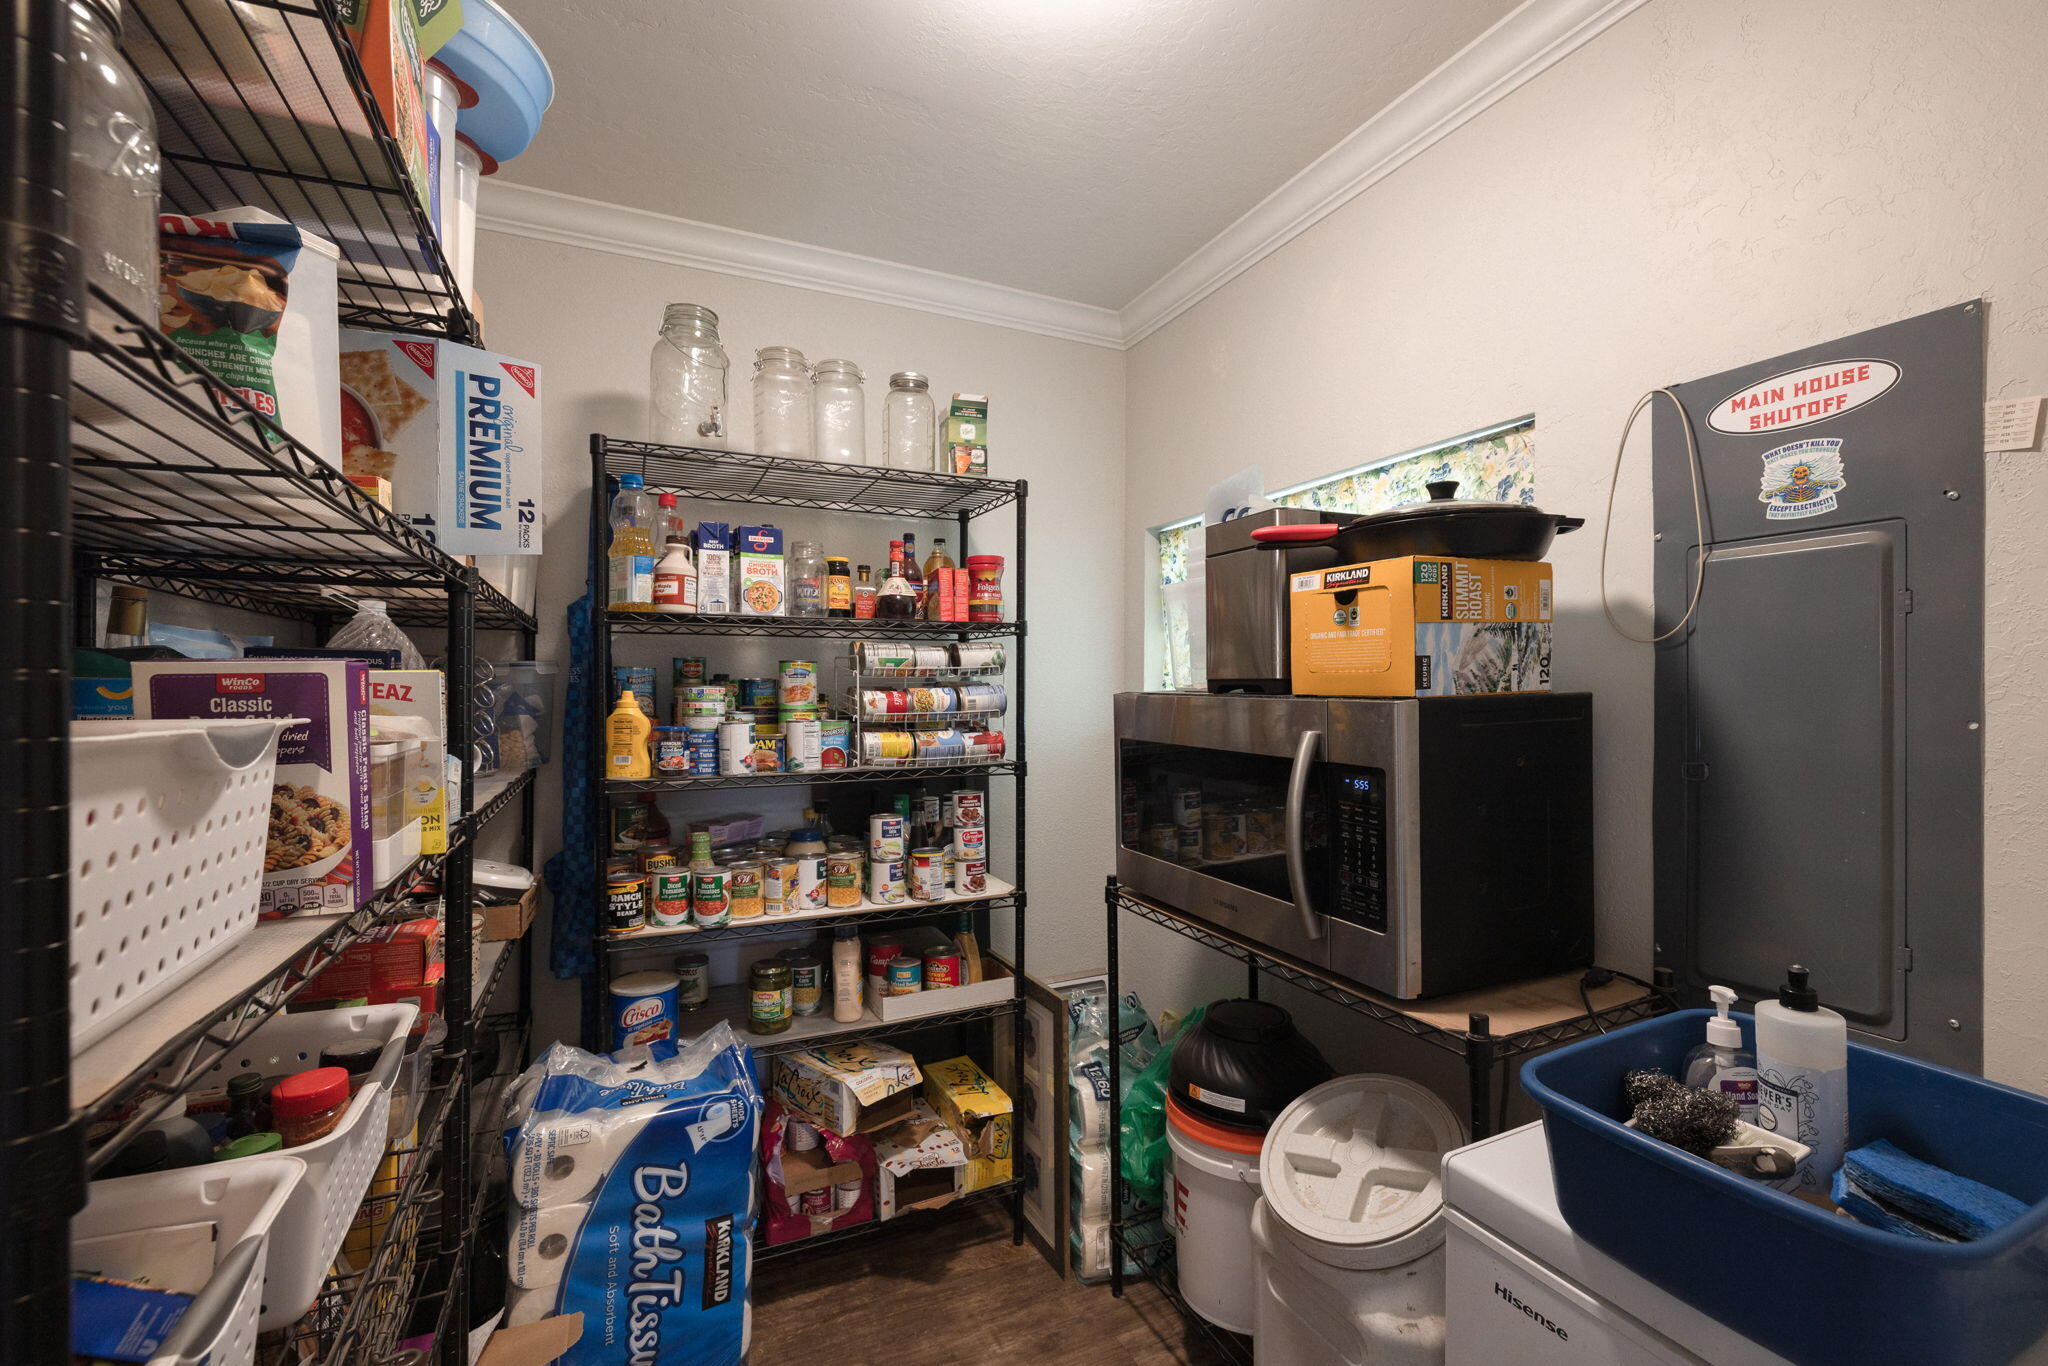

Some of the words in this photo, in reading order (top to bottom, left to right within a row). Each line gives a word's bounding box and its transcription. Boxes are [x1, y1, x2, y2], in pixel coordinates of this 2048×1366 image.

[176, 337, 206, 346] Because
[208, 340, 228, 349] when
[182, 346, 225, 359] RUNCHES
[229, 353, 247, 362] ARE
[409, 345, 431, 366] NABISCO
[212, 360, 254, 372] STRENGTH
[246, 374, 271, 384] become
[512, 367, 533, 387] NABISCO
[1730, 386, 1785, 414] MAIN
[1793, 364, 1871, 397] HOUSE
[1749, 393, 1849, 431] SHUTOFF
[502, 405, 523, 453] original
[469, 373, 502, 531] PREMIUM
[1763, 448, 1781, 461] WHAT
[1782, 441, 1809, 454] DOESN'T
[1826, 439, 1840, 447] YOU
[518, 498, 535, 524] 12
[1769, 504, 1792, 512] EXCEPT
[1793, 496, 1835, 512] ELECTRICITY
[522, 525, 530, 549] PACKS
[746, 567, 778, 576] BROTH
[1326, 568, 1369, 583] KIRKLAND
[1456, 561, 1468, 619] SUMMIT
[1469, 573, 1482, 619] ROAST
[1540, 657, 1551, 686] 120
[221, 678, 260, 686] WinCo
[107, 704, 128, 712] you
[210, 697, 273, 713] Classic
[281, 730, 309, 741] dried
[647, 858, 676, 870] BUSH'S
[609, 900, 643, 911] STYLE
[611, 892, 642, 903] RANCH
[616, 909, 637, 917] BEANS
[623, 1004, 660, 1027] Crisco
[731, 1099, 739, 1128] SHEETS
[737, 1100, 745, 1121] WIDE
[1774, 1103, 1791, 1112] DAY
[547, 1129, 557, 1150] SEPTIC
[546, 1150, 555, 1166] SAFE
[912, 1159, 946, 1170] Shasta
[532, 1162, 541, 1182] ROLLS
[529, 1199, 538, 1221] SHEETS
[528, 1221, 536, 1233] PER
[527, 1233, 536, 1249] ROLL
[609, 1225, 620, 1253] Soft
[607, 1257, 617, 1279] and
[714, 1220, 731, 1302] KIRKLAND
[604, 1282, 618, 1347] Absorbent
[1492, 1281, 1569, 1343] Hisense
